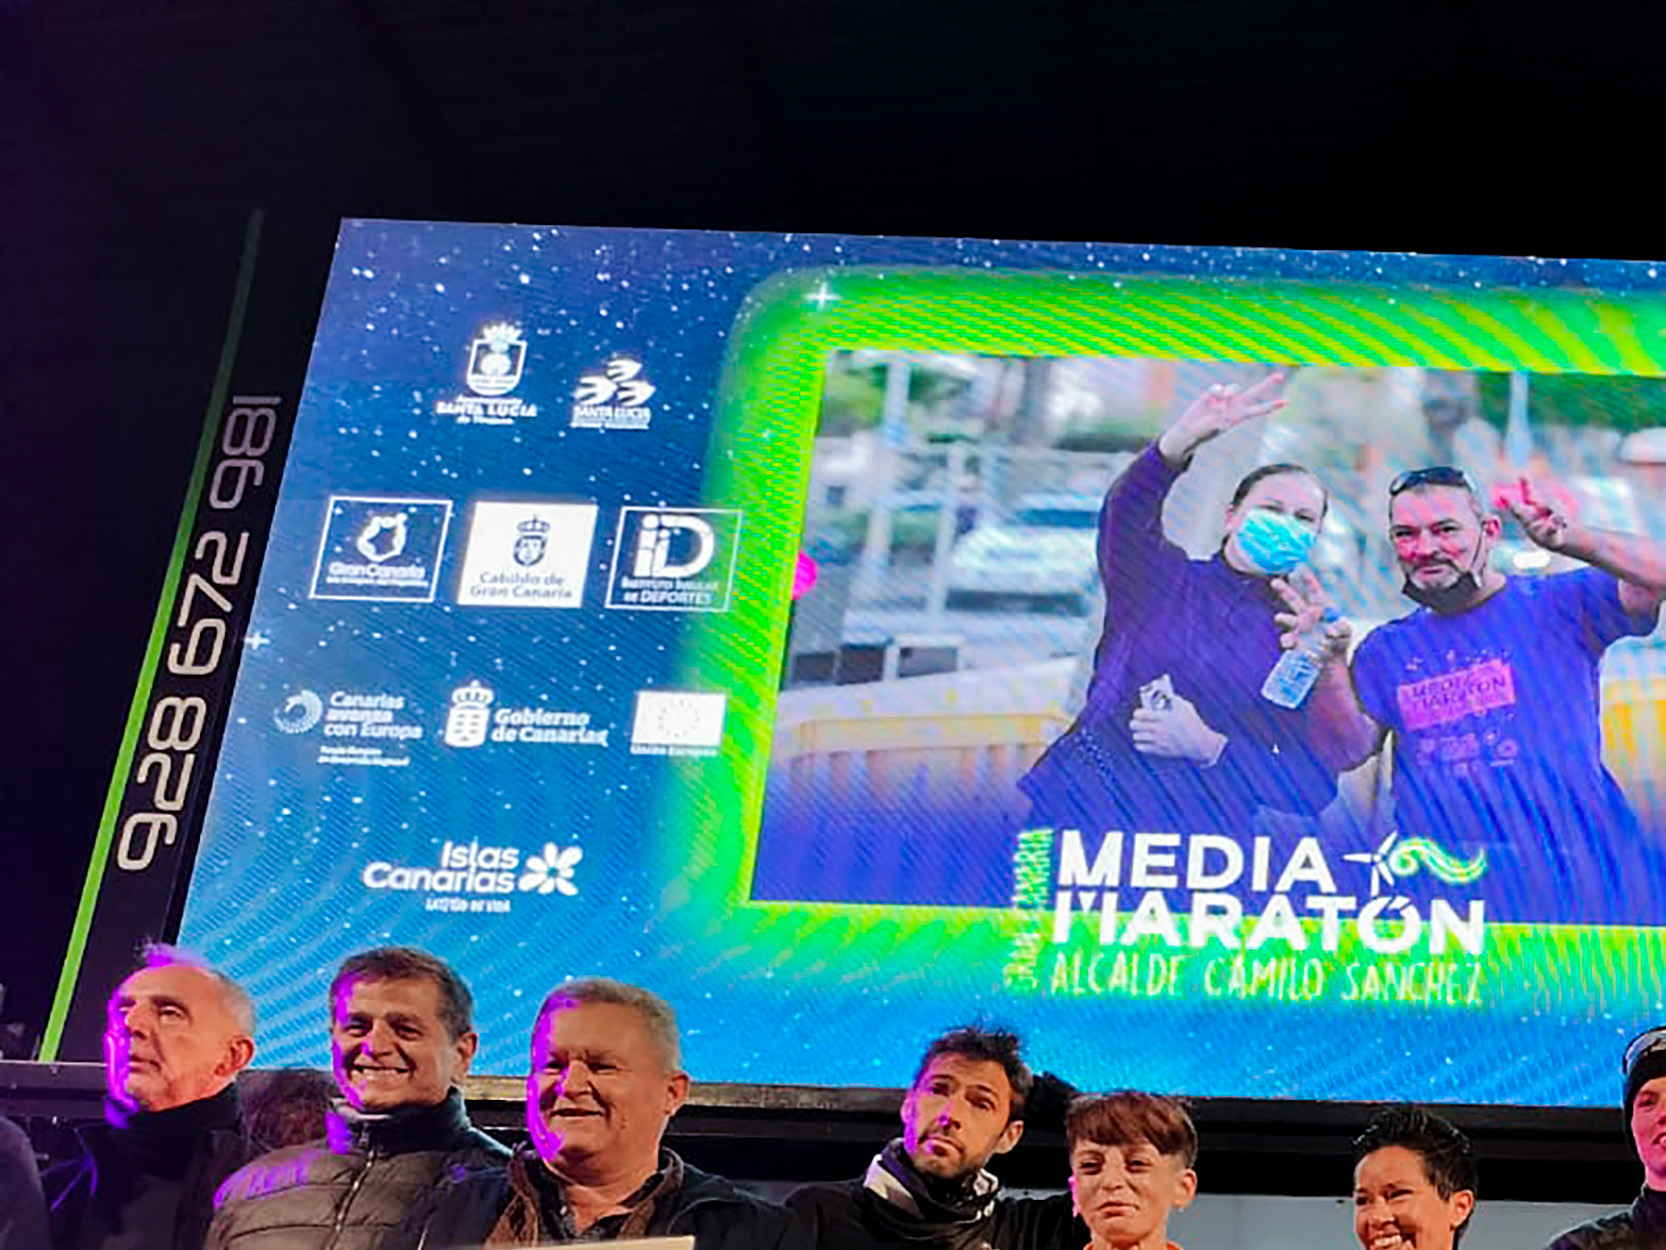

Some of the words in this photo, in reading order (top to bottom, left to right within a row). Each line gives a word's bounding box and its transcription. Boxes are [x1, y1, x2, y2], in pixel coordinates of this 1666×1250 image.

[479, 572, 541, 584] Cabildo
[543, 574, 565, 585] de
[470, 585, 508, 597] Gran
[512, 586, 573, 599] Canaria
[116, 696, 208, 871] 928
[167, 530, 250, 676] 672
[331, 691, 404, 710] Canarias
[494, 707, 591, 727] Gobierno
[324, 724, 357, 736] con
[361, 720, 423, 740] Europa
[441, 841, 520, 869] Islas
[1056, 829, 1337, 893] MEDIA
[363, 862, 516, 894] Canarias
[1202, 956, 1325, 1001] CAMILO
